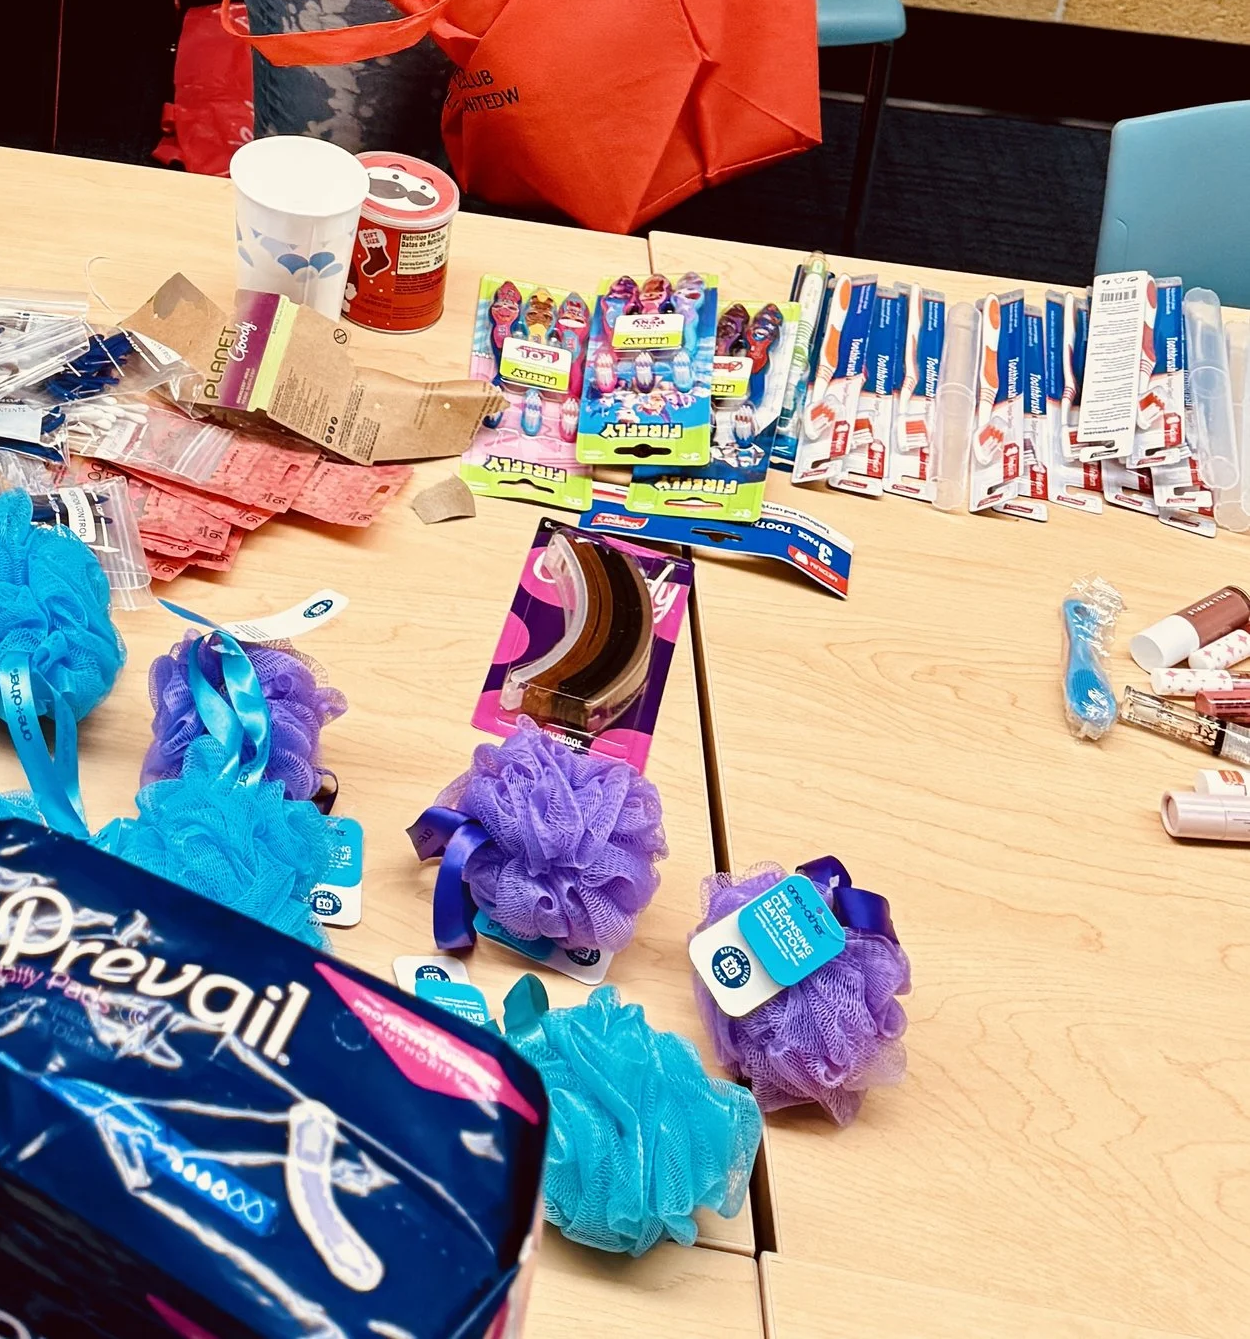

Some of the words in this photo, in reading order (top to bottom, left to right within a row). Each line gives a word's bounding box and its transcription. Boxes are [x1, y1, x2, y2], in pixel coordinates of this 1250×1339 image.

[227, 320, 257, 362] Goody
[622, 336, 669, 346] FIREFLY
[846, 337, 863, 377] Toothbrush
[1165, 337, 1179, 372] Toothbrush
[203, 325, 238, 400] PLANET
[513, 368, 558, 386] FIREFLY
[876, 354, 889, 395] Toothbrush
[925, 357, 939, 397] Toothbrush
[1006, 357, 1020, 398] Toothbrush
[1029, 373, 1042, 415] Toothbrush
[601, 423, 683, 440] FIREFLY
[487, 455, 567, 483] FIREFLY
[653, 475, 738, 495] FIREFLY
[798, 529, 820, 547] PACK
[817, 543, 833, 566] 3
[1188, 598, 1213, 616] PEOPLE
[12, 669, 33, 741] one+other
[762, 899, 788, 931] BATH
[778, 925, 809, 961] POUF
[768, 895, 815, 957] CLEANSING
[722, 959, 737, 976] 30
[458, 1010, 485, 1021] BATH
